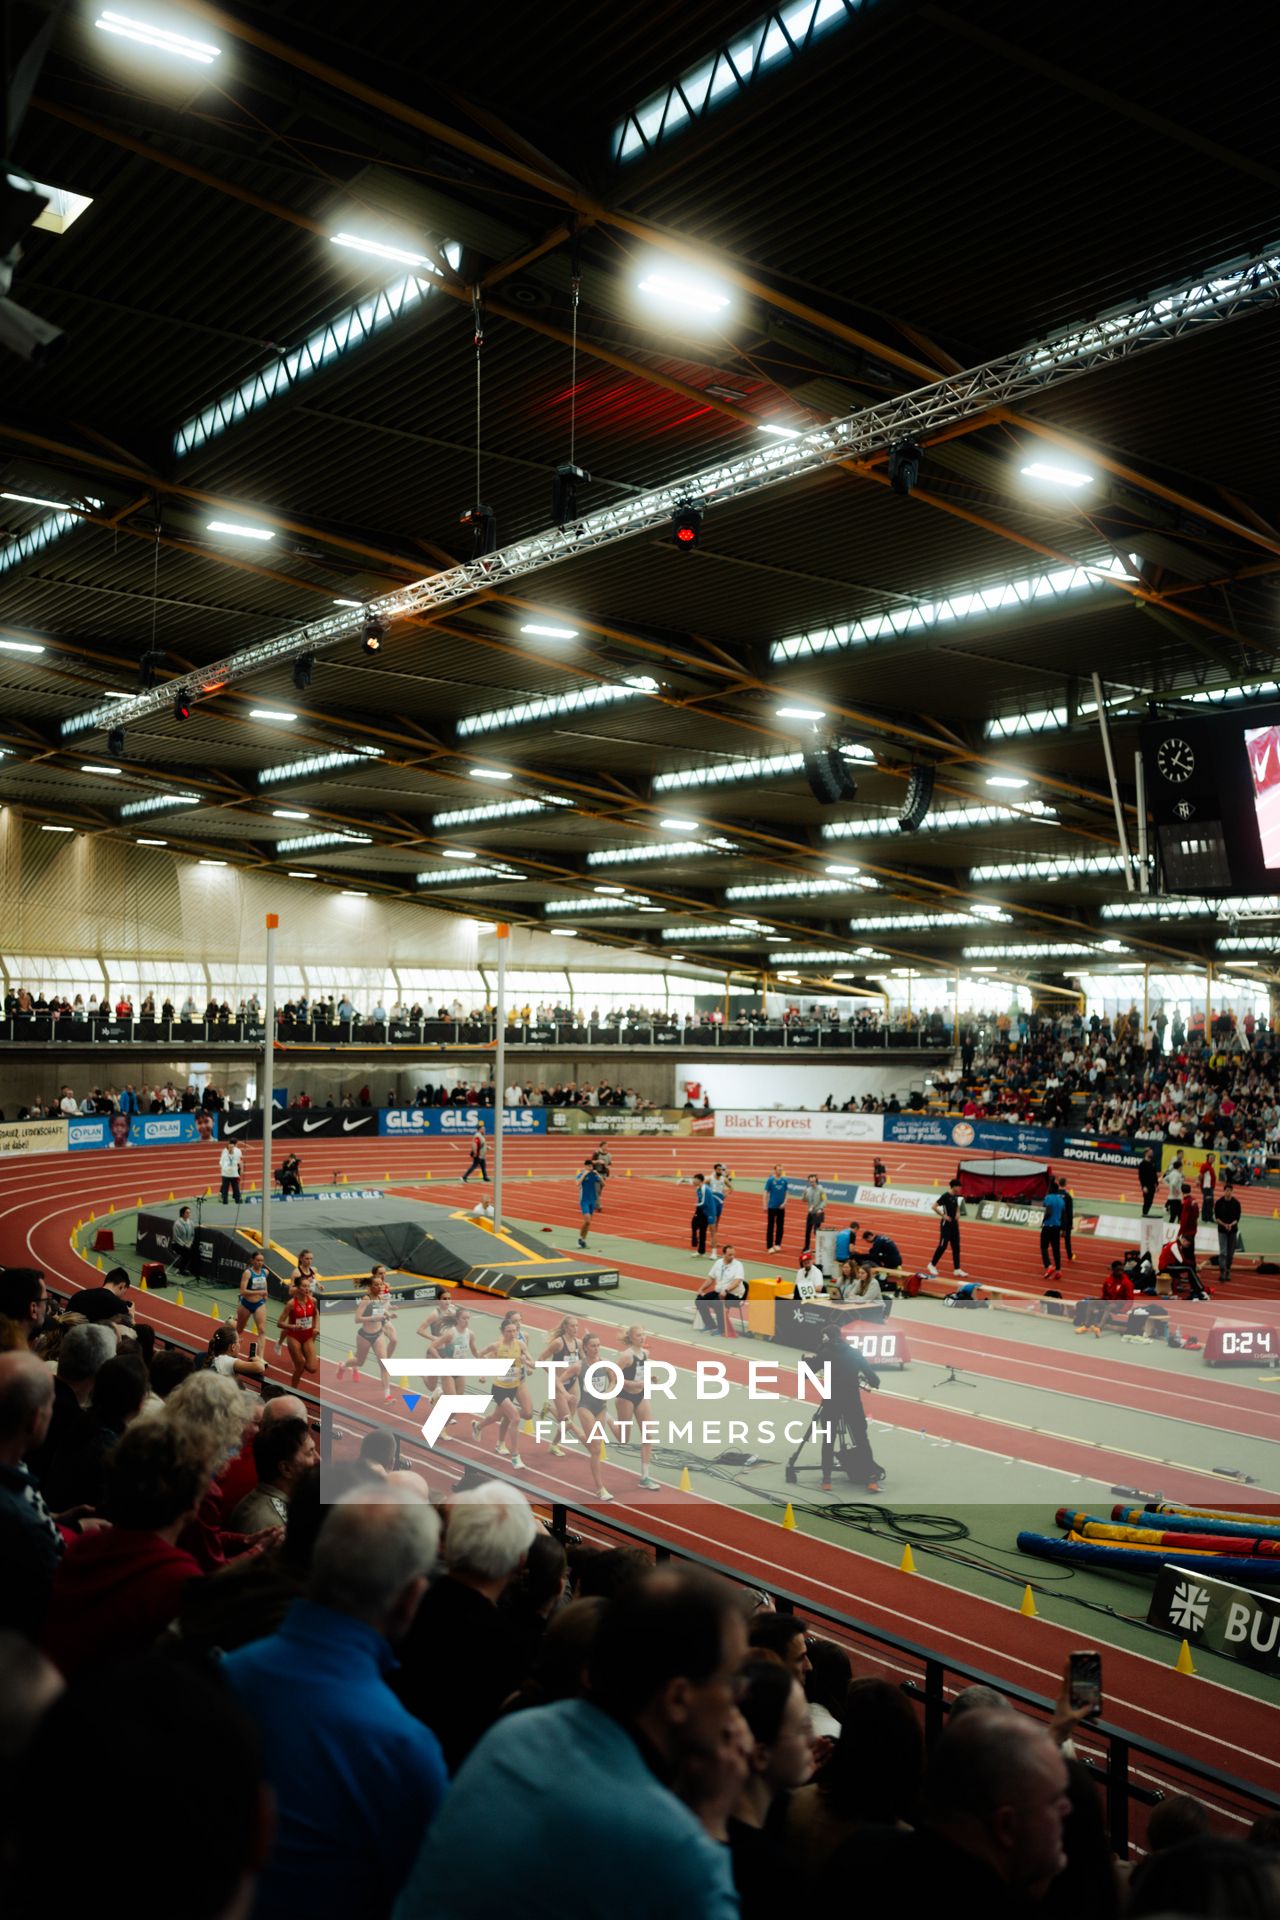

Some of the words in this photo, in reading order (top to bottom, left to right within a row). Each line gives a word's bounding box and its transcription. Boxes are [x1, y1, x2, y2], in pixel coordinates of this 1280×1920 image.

[160, 1123, 178, 1132] PLAN
[724, 1115, 763, 1127] Black
[768, 1116, 811, 1129] Forest
[83, 1127, 101, 1136] PLAN
[860, 1190, 888, 1204] Black
[890, 1193, 920, 1208] Forest
[547, 1281, 566, 1289] WGV
[800, 1286, 814, 1296] 80
[1222, 1332, 1271, 1354] 0:24
[1224, 1602, 1280, 1659] BU
